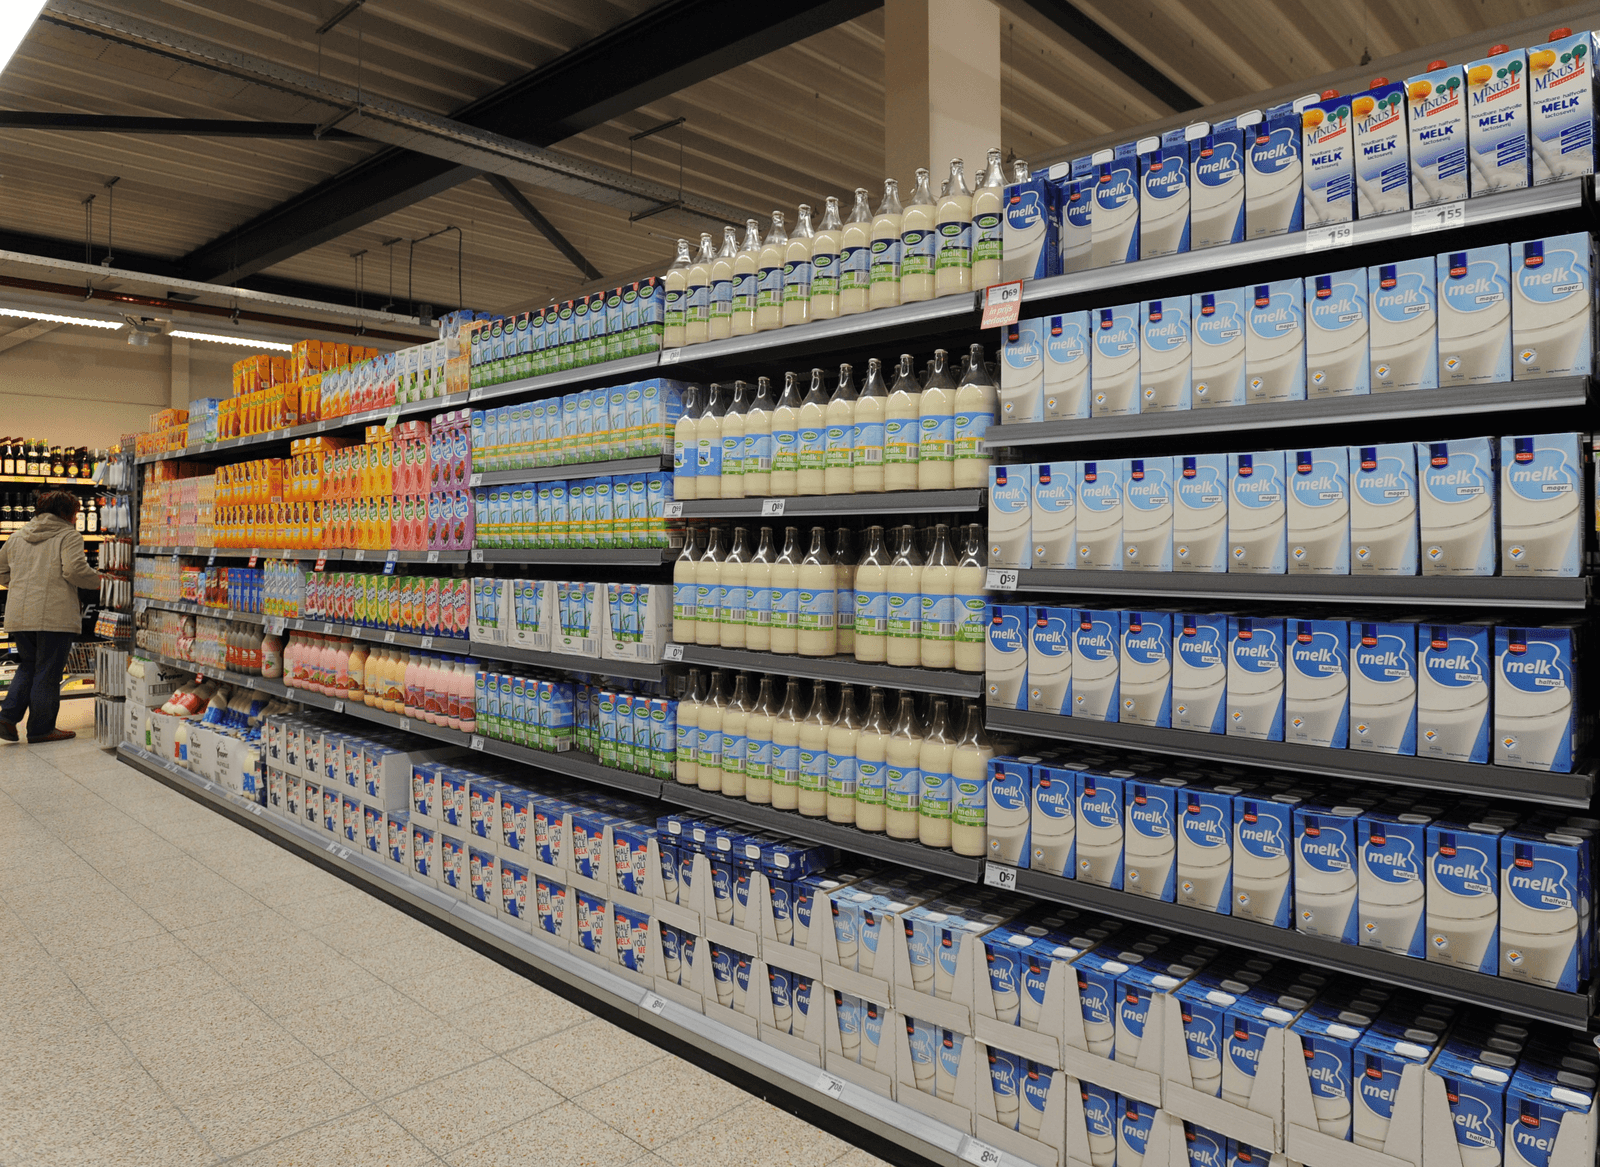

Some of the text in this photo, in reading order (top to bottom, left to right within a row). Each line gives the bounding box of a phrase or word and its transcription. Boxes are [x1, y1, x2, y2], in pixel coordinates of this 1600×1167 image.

[1534, 87, 1588, 106] houdbare halfvolle
[1472, 102, 1523, 120] houdbare halfvolle
[1541, 96, 1579, 114] MELK
[1479, 111, 1514, 128] MELK
[1545, 107, 1576, 119] lactosevrij
[1420, 125, 1453, 141] MELK
[1483, 122, 1511, 134] lactosevrij
[1364, 140, 1396, 155] MELK
[1423, 136, 1450, 146] lactosevrij
[1254, 143, 1287, 162] melk
[1311, 151, 1342, 166] MELK
[1199, 158, 1230, 175] melk
[1148, 174, 1177, 188] melk
[1098, 183, 1125, 199] melk
[1009, 204, 1034, 219] melk
[1523, 267, 1569, 287] melk
[1448, 279, 1491, 297] melk
[1556, 282, 1580, 293] mager
[1379, 290, 1418, 307] melk
[1479, 293, 1500, 303] mager
[997, 305, 1014, 315] prijs
[1315, 299, 1351, 316] melk
[1407, 304, 1426, 313] mager
[1254, 308, 1287, 324] melk
[1340, 314, 1359, 322] mager
[1148, 324, 1178, 338] melk
[1200, 317, 1232, 331] melk
[1277, 322, 1294, 330] mager
[1100, 330, 1128, 344] melk
[1007, 343, 1032, 356] melk
[1050, 338, 1076, 351] melk
[1359, 474, 1398, 490] melk
[1430, 469, 1471, 487] melk
[1513, 467, 1558, 483] melk
[1131, 483, 1160, 496] melk
[1182, 480, 1213, 494] melk
[1237, 478, 1270, 494] melk
[1296, 476, 1332, 491] melk
[1459, 486, 1480, 495] mager
[1545, 484, 1568, 493] mager
[995, 488, 1020, 499] melk
[1039, 487, 1065, 499] melk
[1084, 485, 1112, 498] melk
[1261, 494, 1278, 502] mager
[992, 629, 1016, 640] melk
[1035, 631, 1061, 643] melk
[1079, 634, 1106, 647] melk
[1128, 637, 1158, 650] melk
[1182, 641, 1213, 654] melk
[1237, 645, 1269, 658] melk
[1296, 648, 1331, 663] melk
[1360, 651, 1398, 667] melk
[1429, 655, 1470, 671] melk
[1386, 669, 1407, 677] halfvol
[1507, 659, 1551, 675] melk
[157, 672, 183, 681] Yopper
[1458, 673, 1479, 682] halfvol
[1537, 679, 1561, 688] halfvol
[994, 786, 1018, 798] melk
[1039, 792, 1064, 806] melk
[958, 808, 977, 817] melk
[1084, 800, 1111, 815] melk
[1133, 811, 1162, 825] melk
[1186, 820, 1217, 834] melk
[1242, 829, 1275, 845] melk
[1264, 846, 1283, 855] halfvol
[1304, 843, 1340, 858] melk
[1329, 860, 1350, 869] halfvol
[1369, 851, 1407, 868] melk
[1394, 870, 1417, 879] halfvol
[1437, 863, 1479, 880] melk
[1466, 882, 1489, 893] halfvol
[1512, 876, 1558, 895] melk
[1543, 896, 1568, 907] halfvol
[1323, 1085, 1342, 1096] halfvol
[1364, 1081, 1398, 1101] mel
[1470, 1132, 1491, 1145] halfvol
[1518, 1132, 1553, 1152] mel
